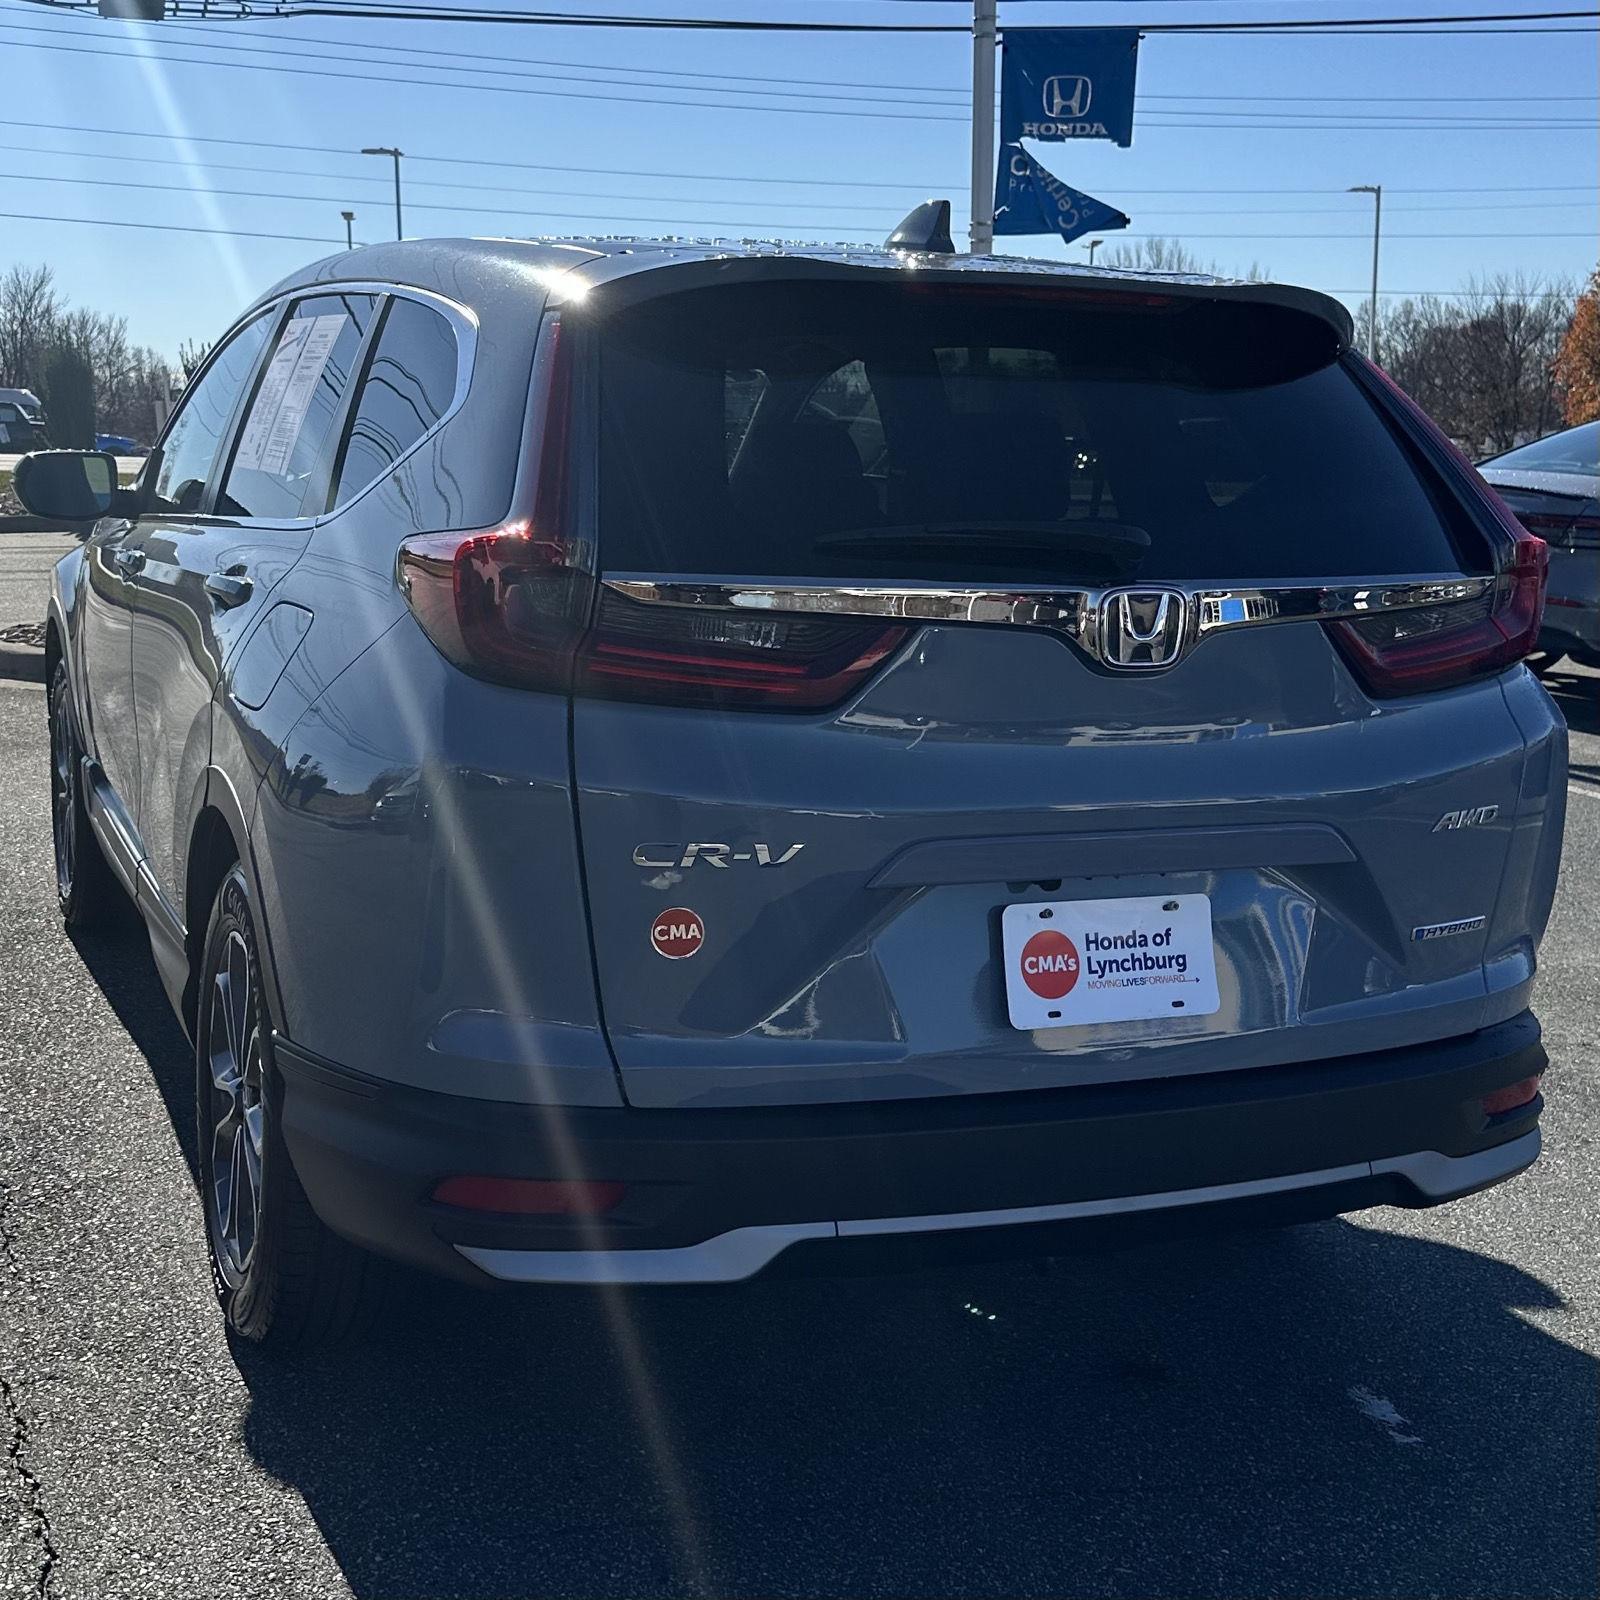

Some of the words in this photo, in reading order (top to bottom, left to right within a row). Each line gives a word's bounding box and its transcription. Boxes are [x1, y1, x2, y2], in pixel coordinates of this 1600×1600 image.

[1022, 122, 1108, 136] HONDA
[1432, 805, 1499, 833] AWD
[632, 842, 806, 868] CR-V
[654, 923, 702, 942] CMA
[1085, 929, 1148, 951] Honda
[1152, 927, 1172, 946] of
[1424, 919, 1483, 938] HYBRID
[1024, 953, 1078, 975] CMA's
[1087, 952, 1187, 979] Lynchburg
